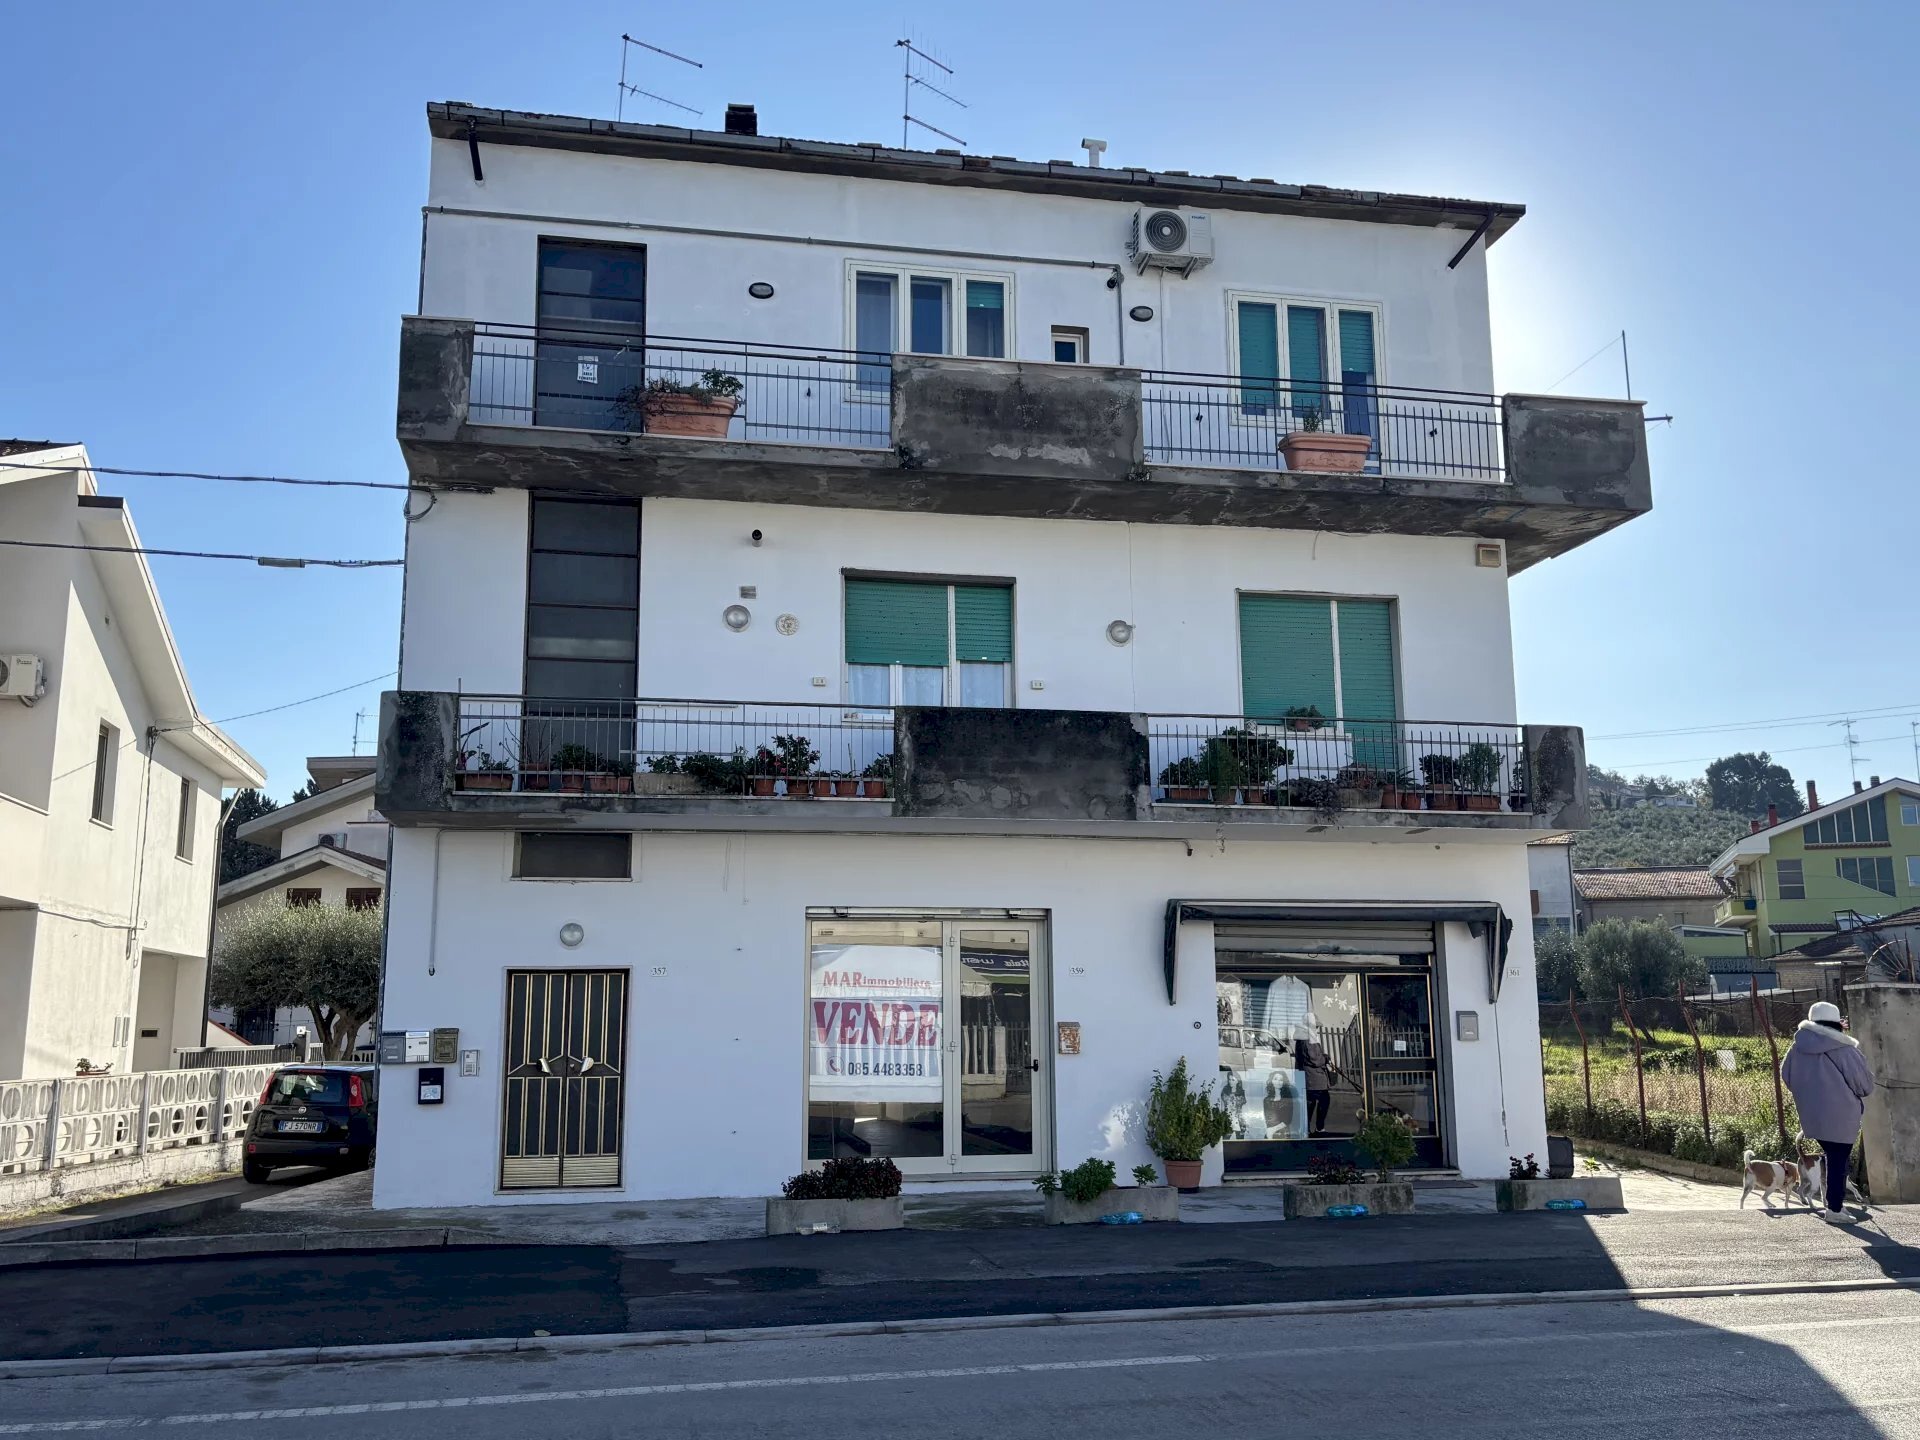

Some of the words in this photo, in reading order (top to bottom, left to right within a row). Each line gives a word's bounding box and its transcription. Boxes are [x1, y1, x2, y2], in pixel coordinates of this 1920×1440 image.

[652, 967, 667, 976] 357
[1070, 967, 1084, 975] 359
[813, 1001, 939, 1046] VENDE
[848, 1062, 923, 1076] 085.4483358
